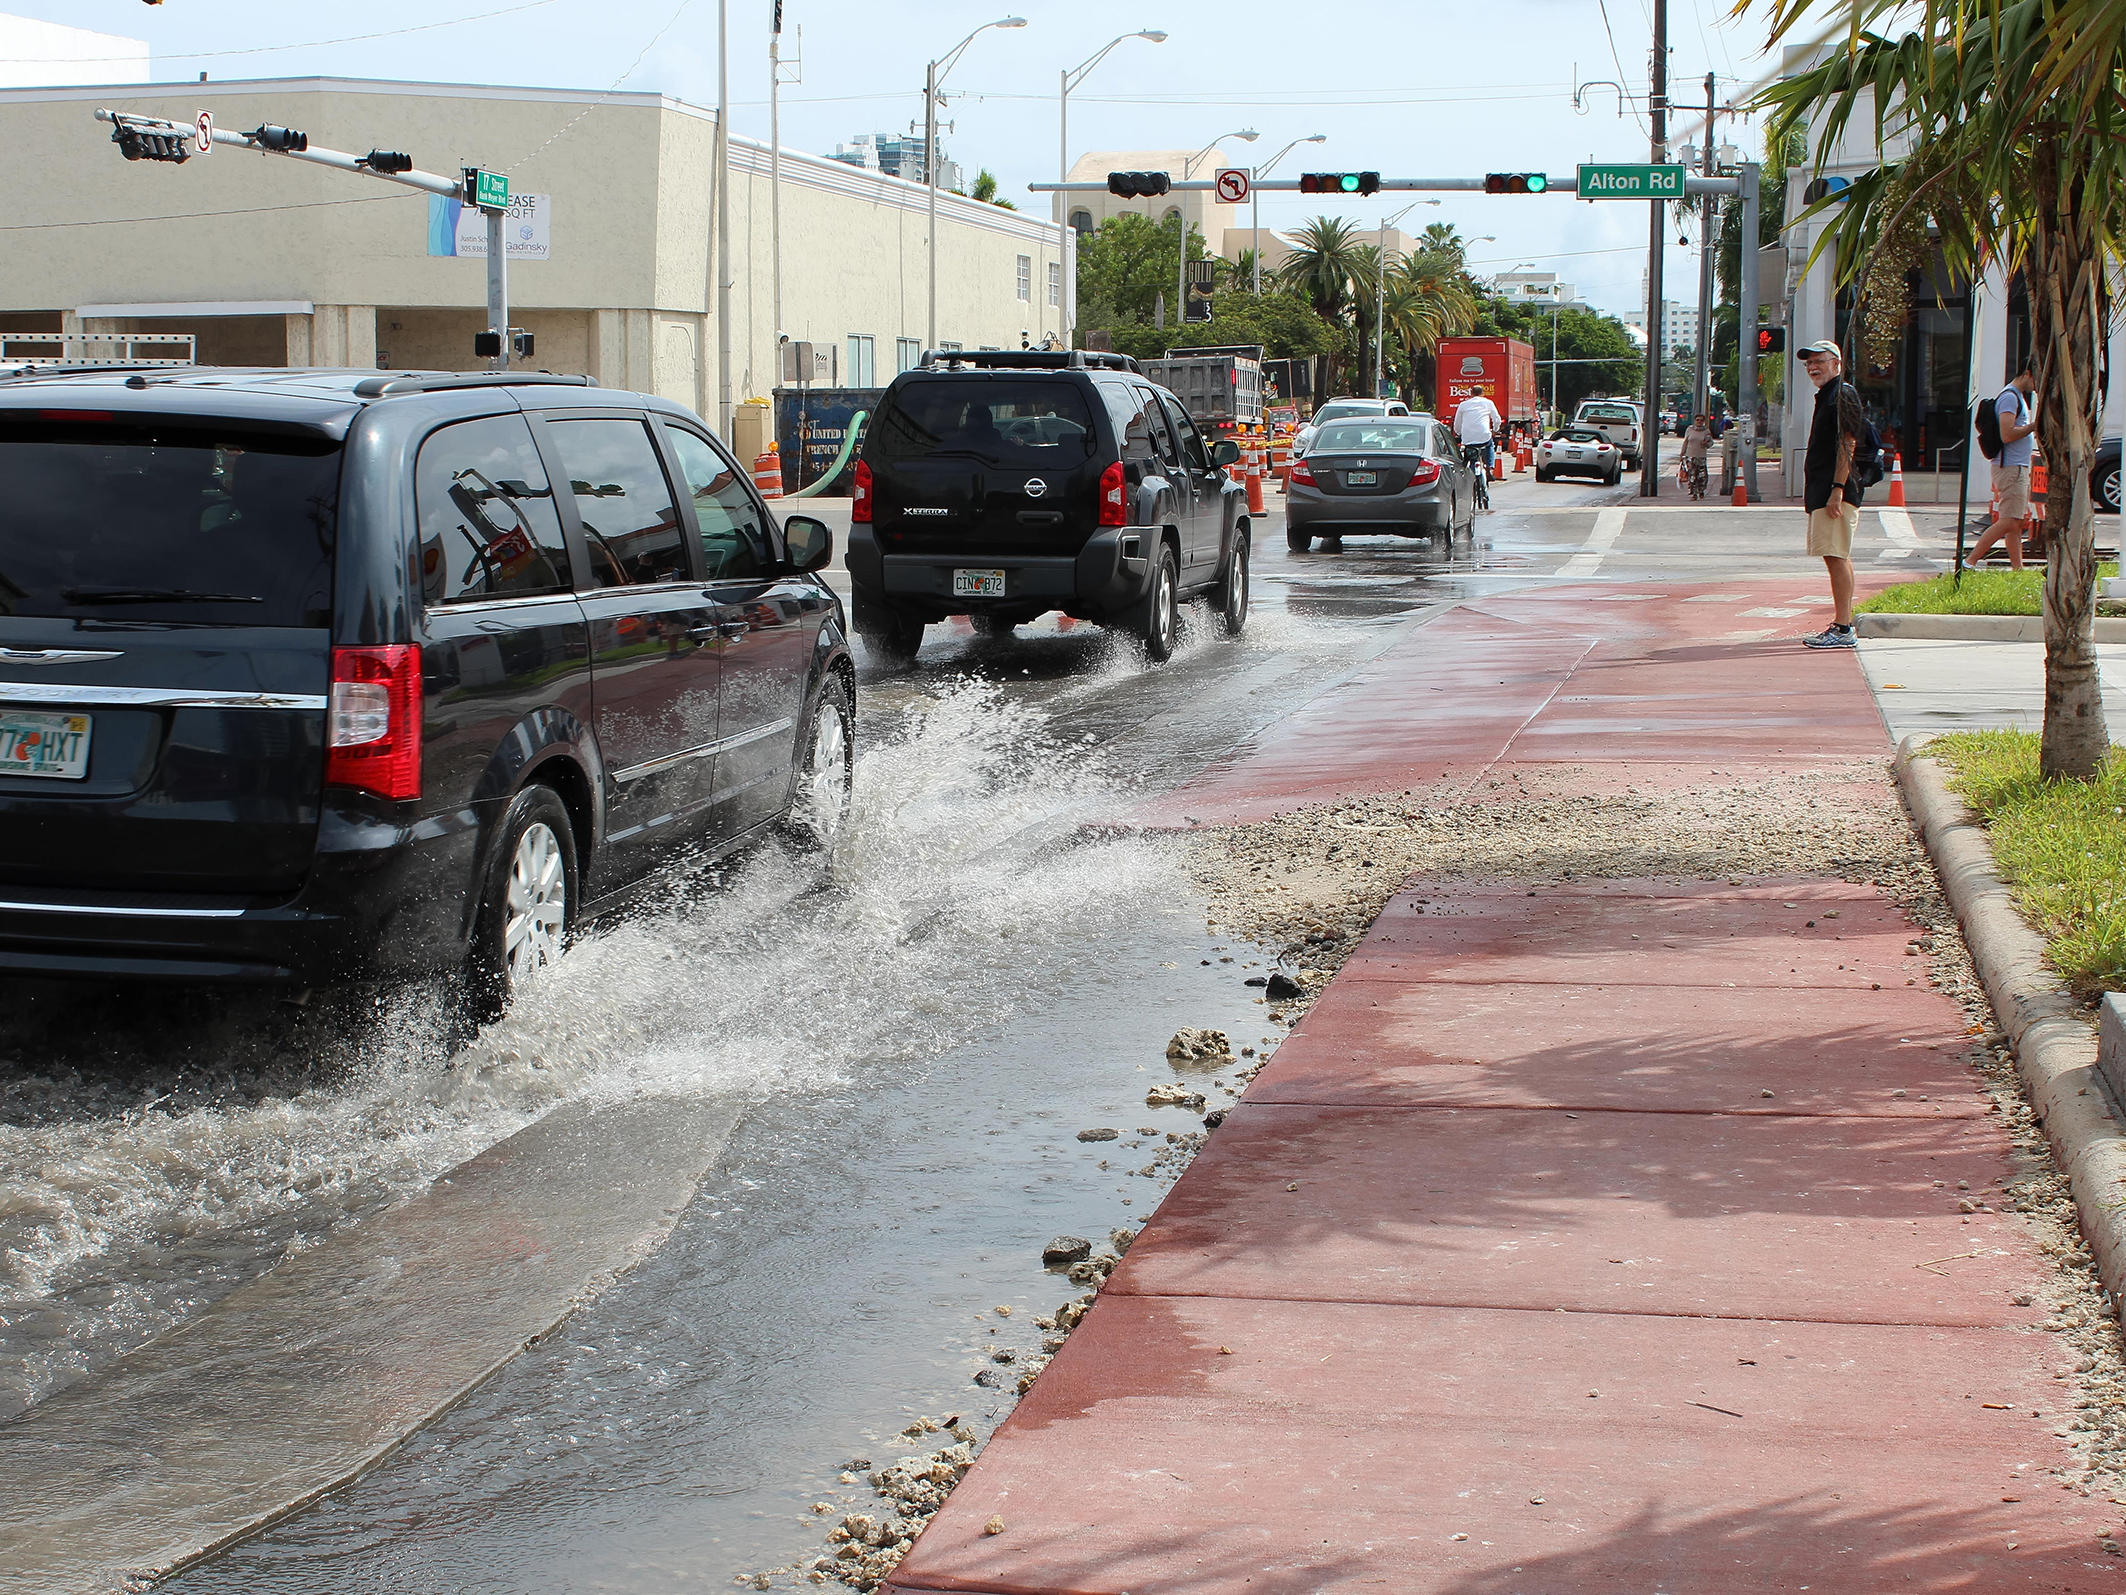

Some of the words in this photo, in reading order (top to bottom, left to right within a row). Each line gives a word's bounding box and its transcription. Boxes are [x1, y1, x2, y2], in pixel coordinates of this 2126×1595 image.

[483, 174, 490, 191] 17
[491, 177, 505, 193] Street
[1588, 172, 1640, 189] Alton
[1649, 172, 1676, 189] Rd
[523, 209, 536, 219] FT
[461, 235, 477, 243] Justin
[506, 241, 548, 255] Gadinsky
[1188, 262, 1212, 283] GOLD
[1450, 385, 1473, 397] Best
[812, 428, 842, 440] UNITED
[805, 444, 839, 455] TRENCH
[956, 577, 974, 590] CIN
[984, 577, 1002, 591] B72
[6, 686, 142, 699] COUNTRY
[41, 731, 84, 763] HXT
